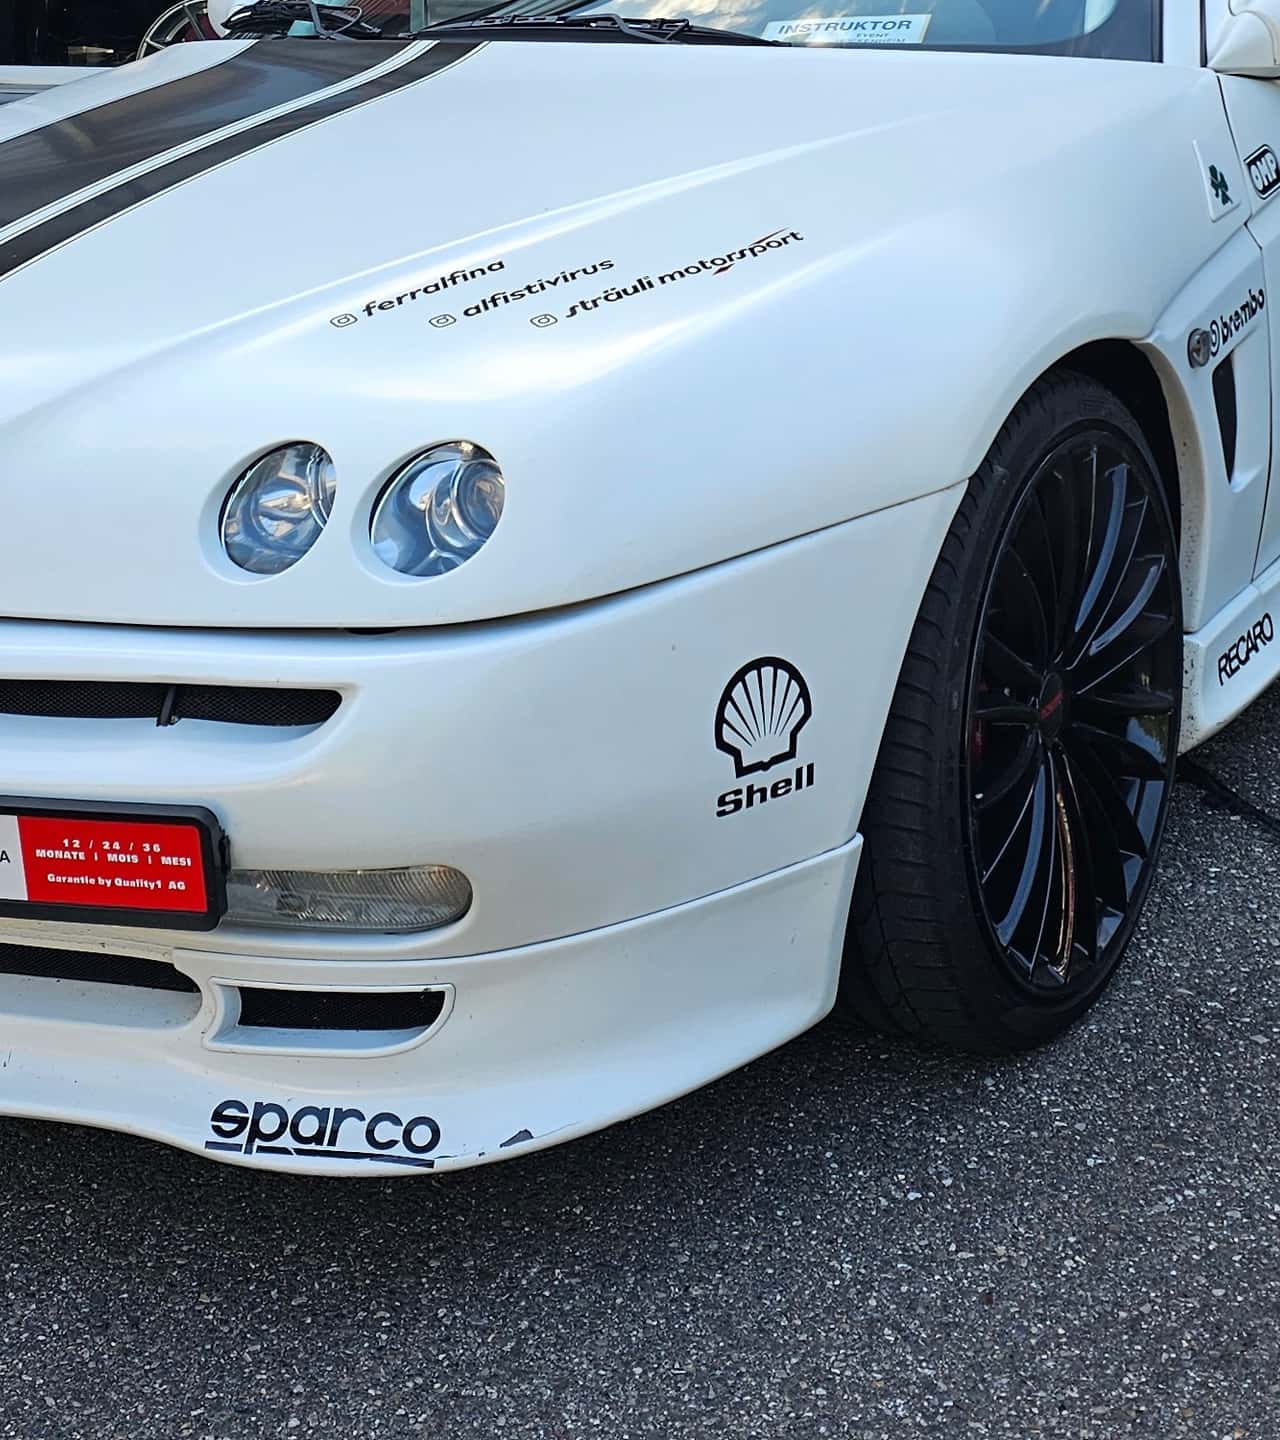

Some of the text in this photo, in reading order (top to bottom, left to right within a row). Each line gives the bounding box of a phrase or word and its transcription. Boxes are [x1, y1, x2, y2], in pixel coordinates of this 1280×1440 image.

[778, 20, 913, 35] INSTRUKTOR
[1248, 150, 1279, 192] OMP
[362, 259, 506, 317] ferralfina
[463, 258, 616, 318] alfistivirus
[565, 229, 804, 319] sträuli motorsport
[1221, 288, 1265, 345] brembo
[1218, 612, 1274, 687] RECARO
[716, 762, 815, 818] Shell
[35, 849, 86, 861] MONATE
[107, 853, 139, 864] MOIS
[160, 856, 192, 867] MESI
[63, 838, 81, 849] 12
[102, 841, 121, 851] 24
[142, 843, 161, 853] 36
[47, 873, 96, 885] Garantie
[98, 876, 112, 888] by
[168, 881, 186, 891] AG
[210, 1099, 441, 1155] sparco
